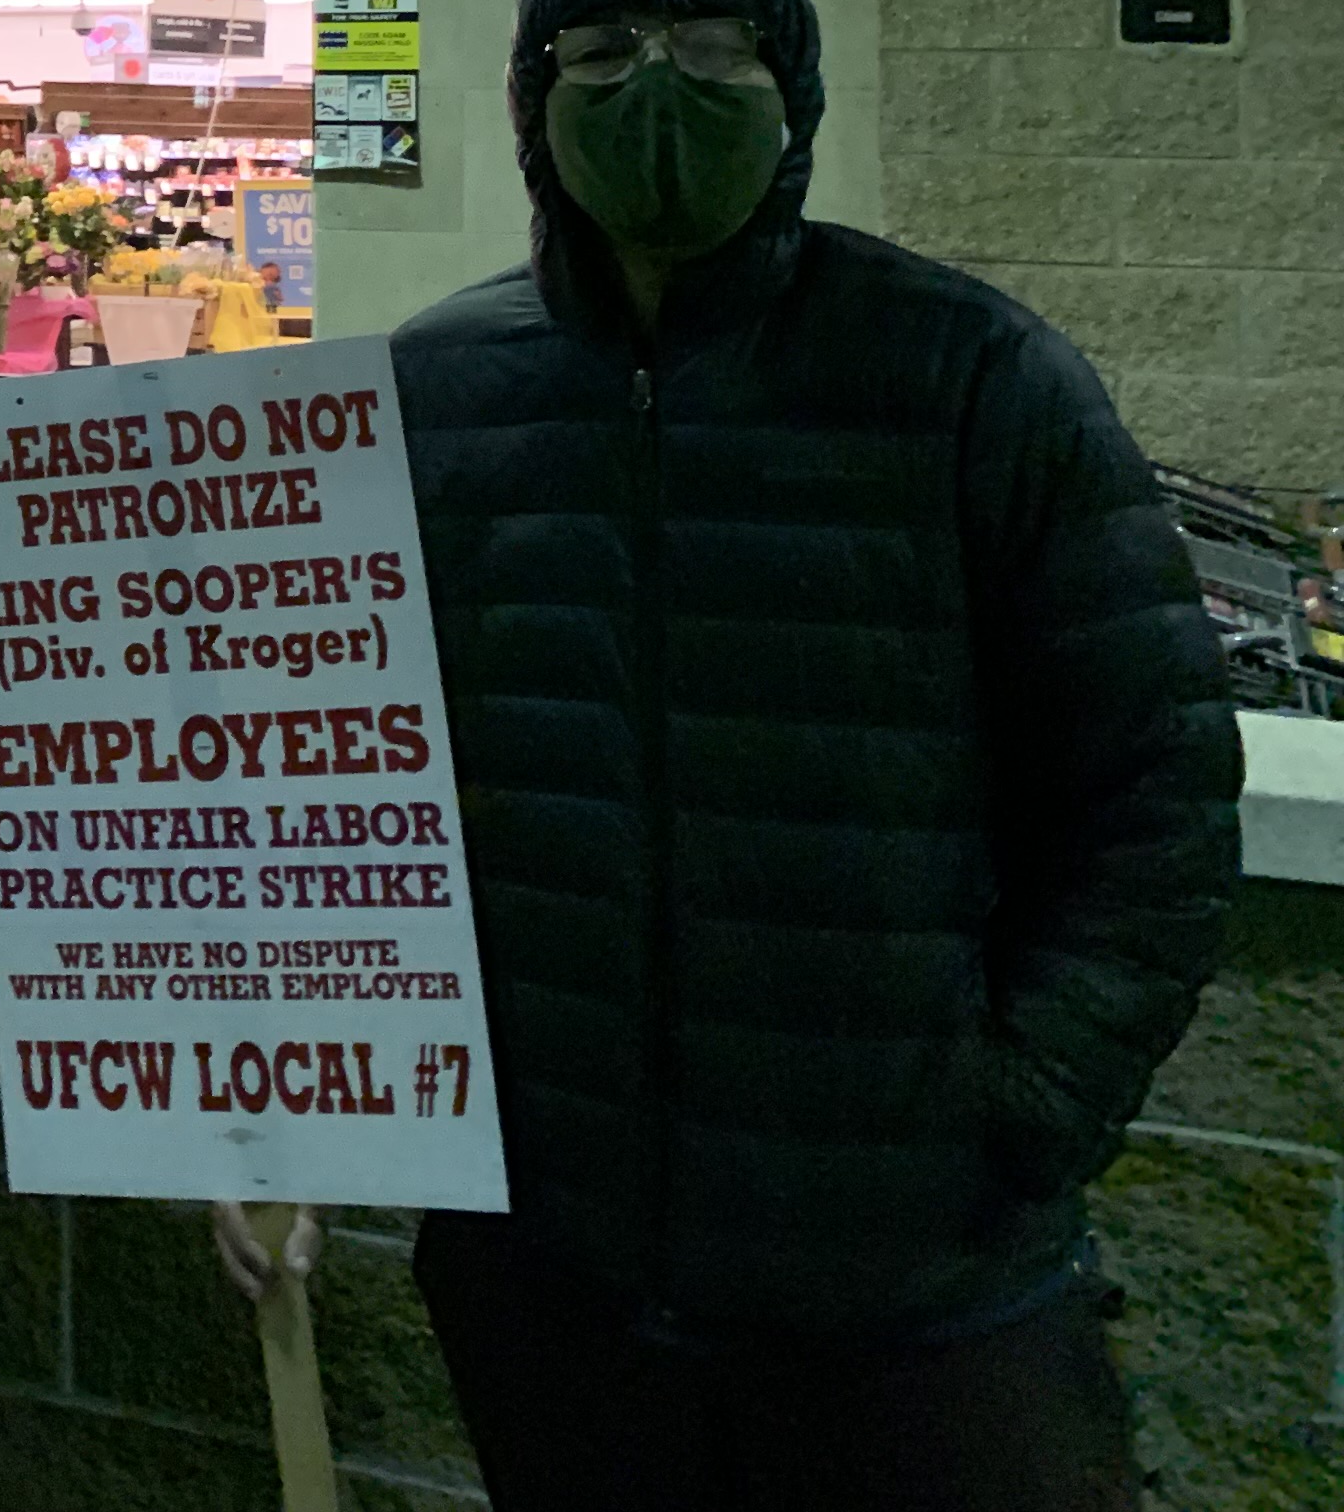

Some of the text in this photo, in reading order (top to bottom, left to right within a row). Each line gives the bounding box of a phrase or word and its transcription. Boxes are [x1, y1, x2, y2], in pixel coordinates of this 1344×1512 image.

[164, 403, 247, 466] DO
[262, 390, 379, 457] NOT
[17, 468, 322, 547] PATRONIZE
[116, 551, 407, 619] SOOPER'S
[124, 629, 170, 676] of
[185, 613, 388, 678] Kroger)
[70, 806, 256, 851] UNFAIR
[265, 801, 449, 850] LABOR
[258, 863, 452, 909] STRIKE
[9, 972, 462, 1000] WITH ANY OTHER EMPLOYER
[56, 939, 400, 969] WE HAVE NO DISPUTE
[17, 1039, 471, 1118] UFCW LOCAL #7
